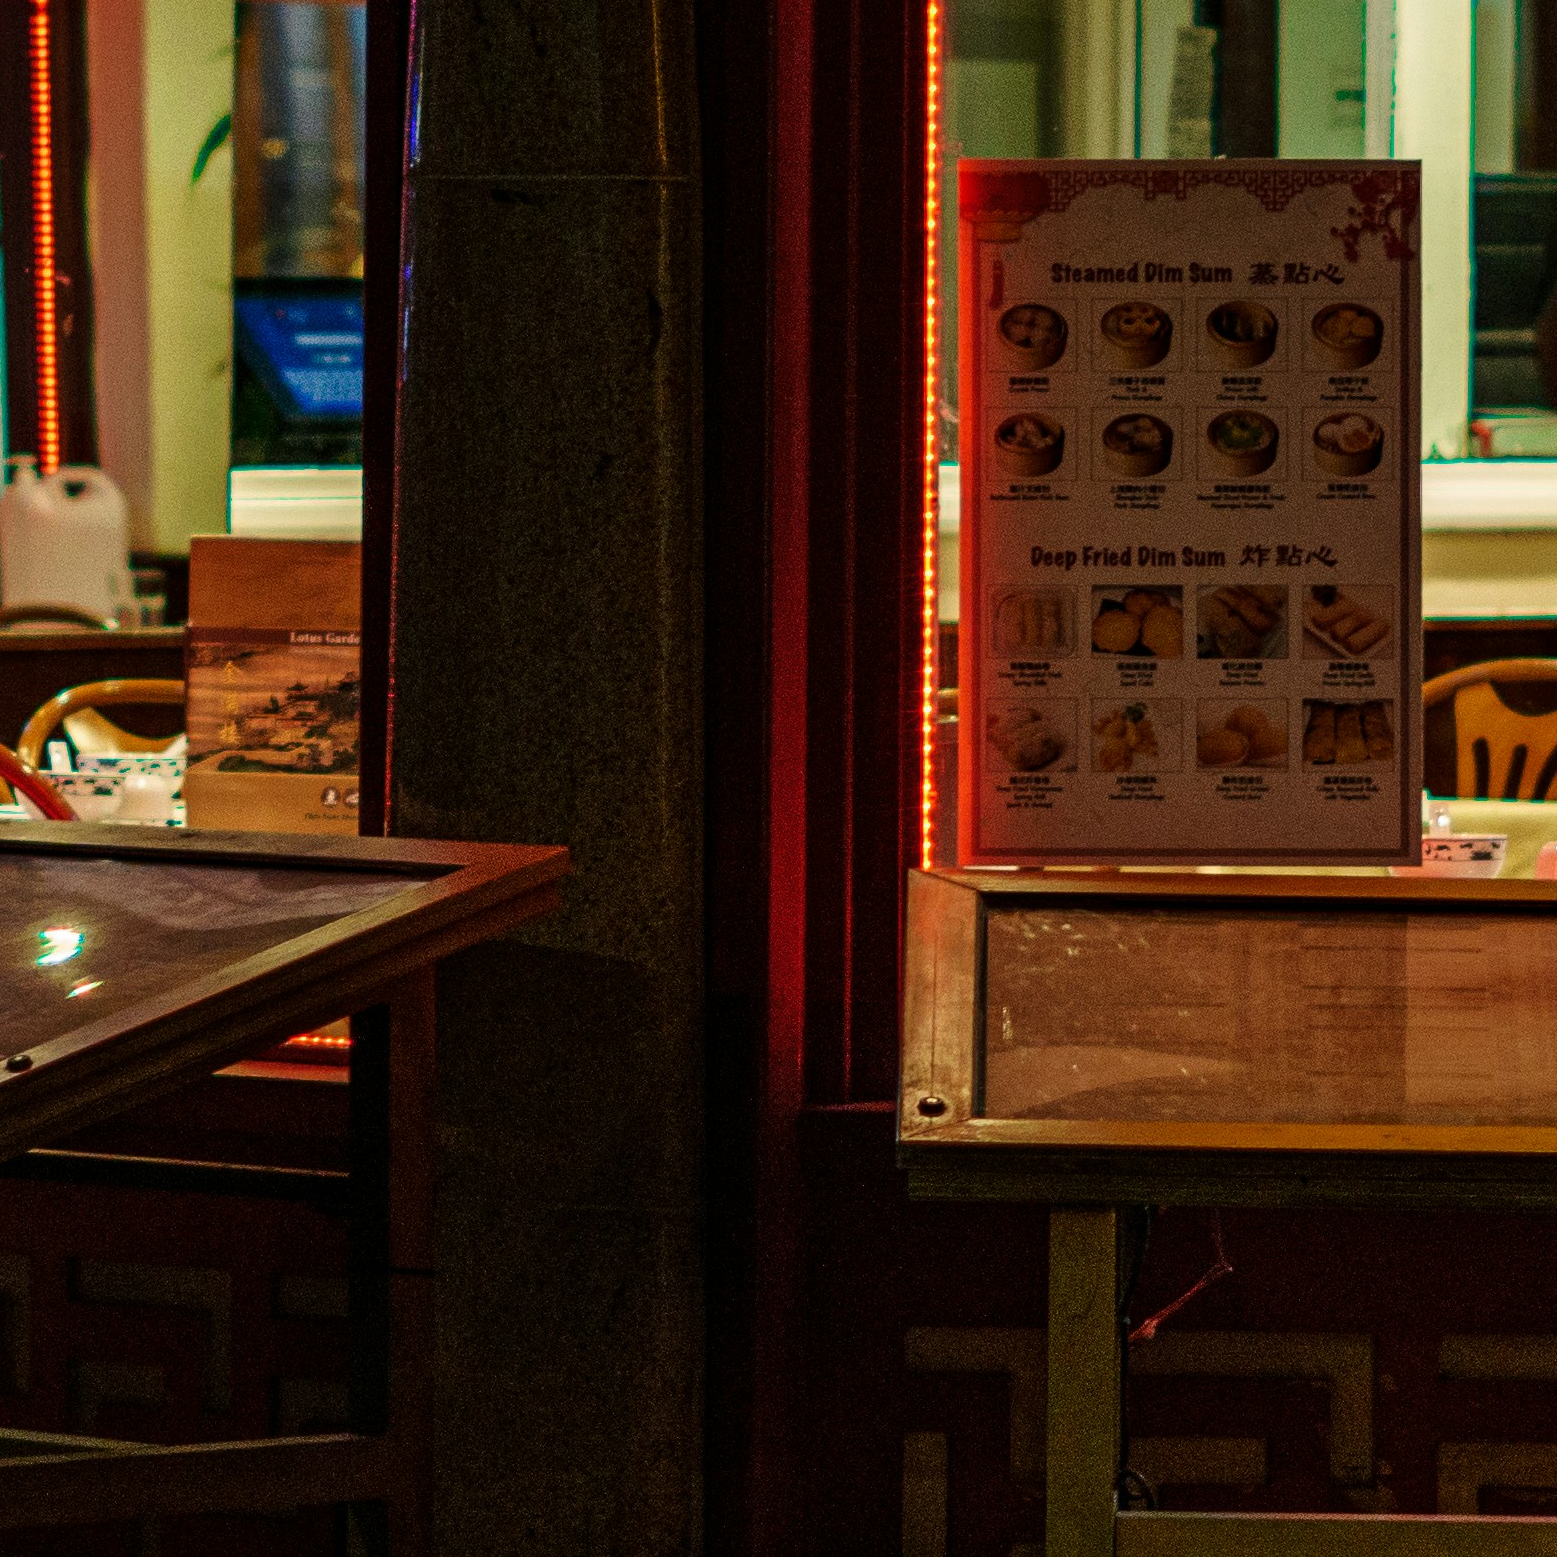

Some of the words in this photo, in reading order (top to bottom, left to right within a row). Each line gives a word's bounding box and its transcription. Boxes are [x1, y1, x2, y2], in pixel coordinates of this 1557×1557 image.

[1050, 262, 1139, 284] Steamed
[1144, 262, 1184, 284] Dim
[1188, 262, 1233, 284] Sum
[1030, 545, 1077, 571] Deep
[1082, 545, 1132, 567] Fried
[1137, 545, 1177, 567] Dim
[1181, 545, 1226, 567] Sum
[1239, 543, 1338, 568] 炸點心
[290, 631, 322, 643] Lotus
[325, 632, 360, 644] Garde
